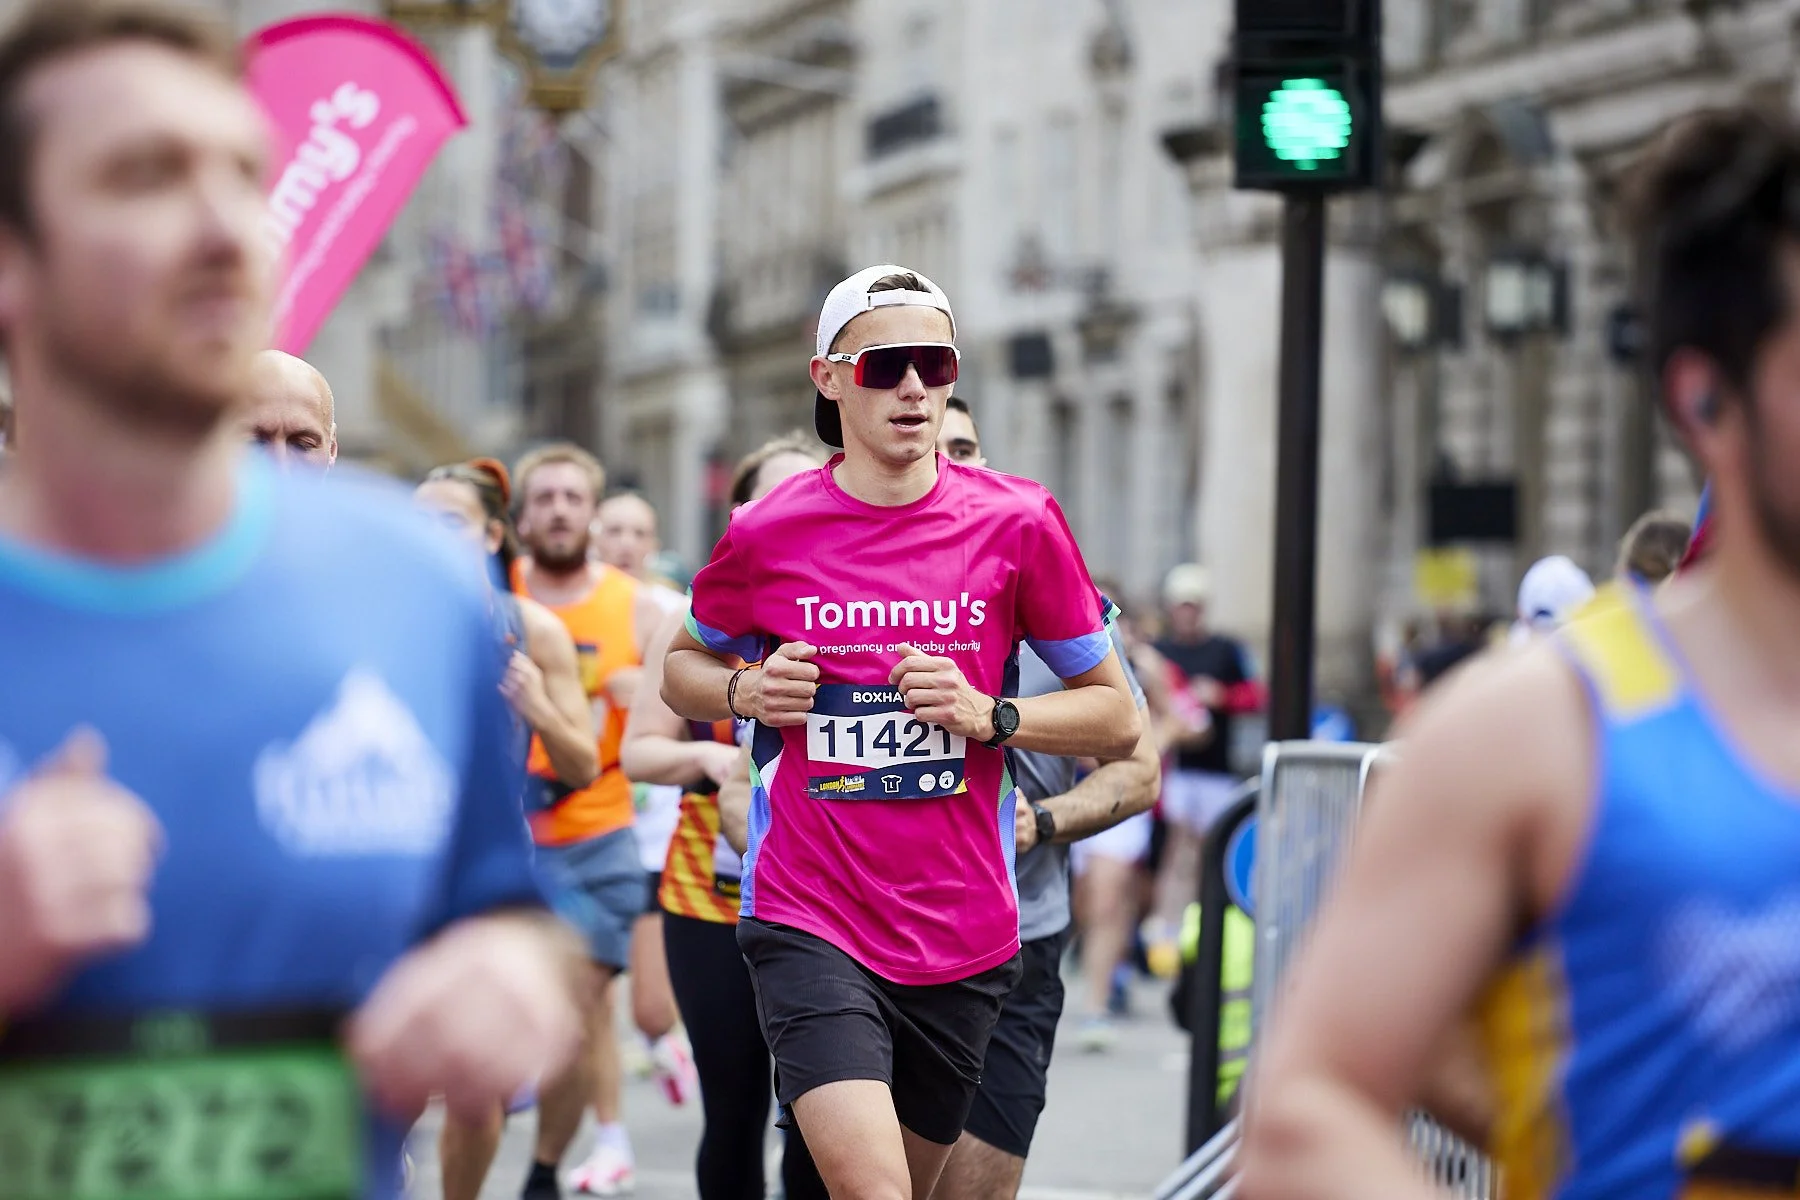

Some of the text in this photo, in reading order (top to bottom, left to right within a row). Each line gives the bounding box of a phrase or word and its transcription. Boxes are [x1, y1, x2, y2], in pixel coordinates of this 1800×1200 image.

[796, 592, 986, 635] Tommy's
[820, 643, 883, 655] pregnancy
[914, 640, 945, 654] baby
[948, 640, 981, 652] charity
[852, 691, 908, 704] BOXHA
[819, 719, 951, 758] 11421
[889, 781, 894, 789] L
[944, 778, 949, 786] 4
